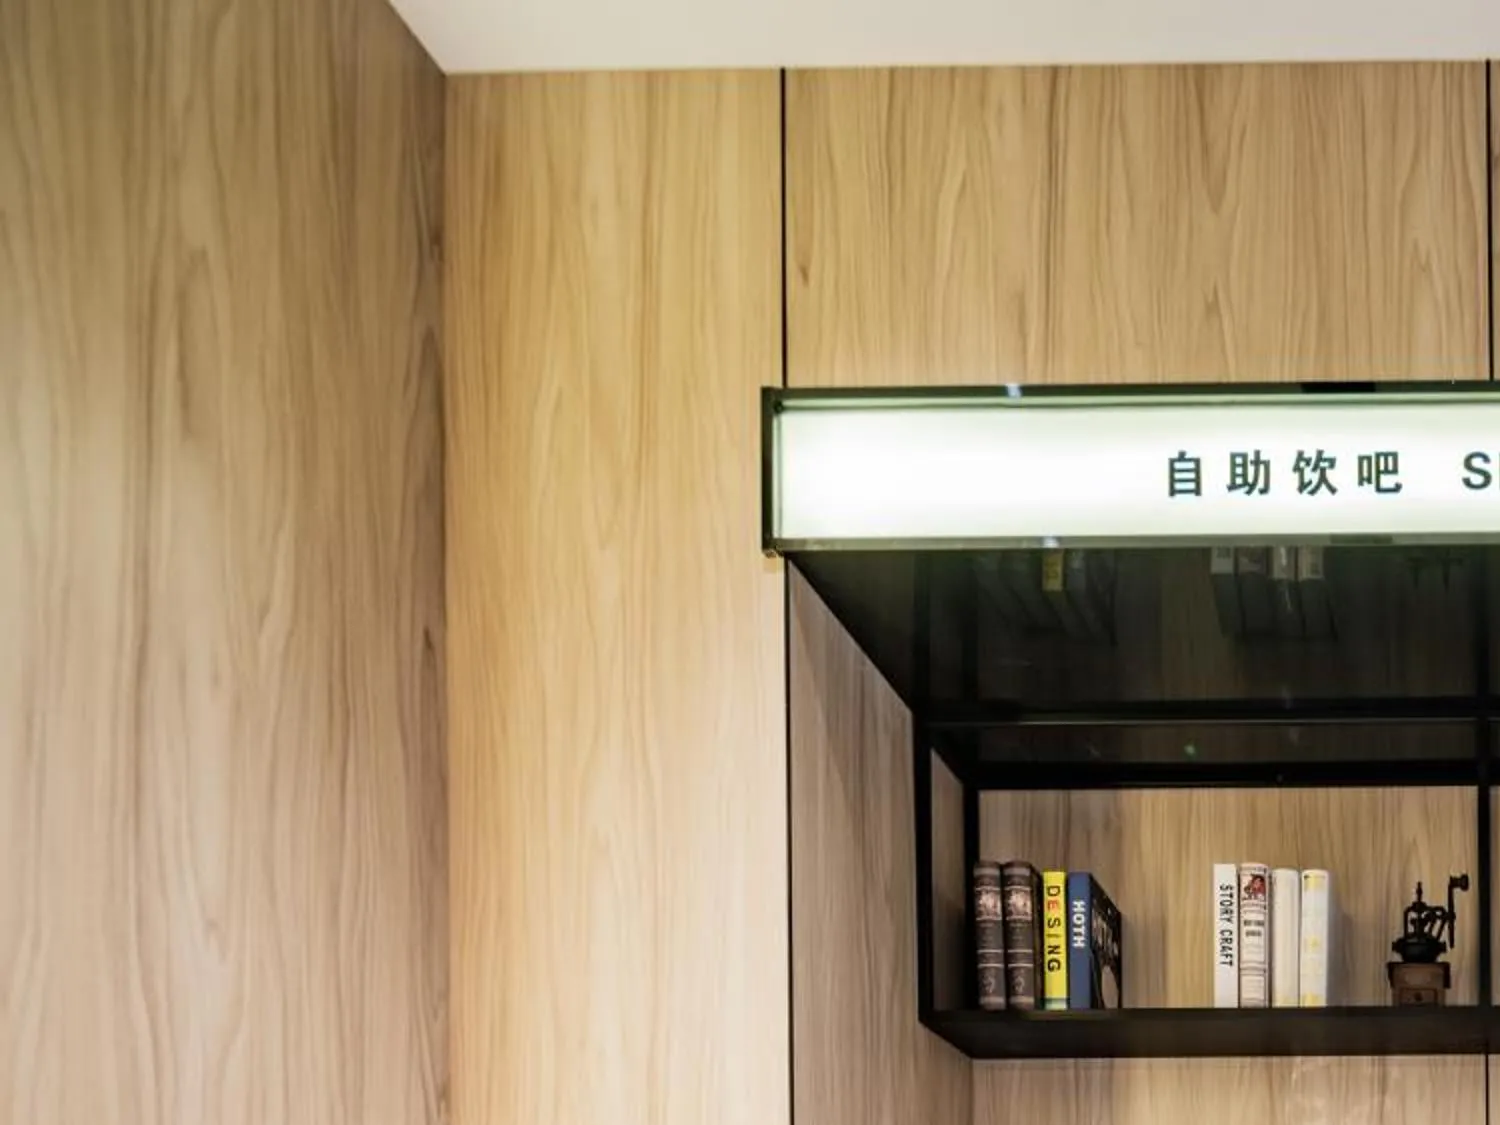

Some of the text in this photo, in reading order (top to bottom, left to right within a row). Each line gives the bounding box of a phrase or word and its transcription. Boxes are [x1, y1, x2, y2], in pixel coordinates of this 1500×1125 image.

[1166, 449, 1403, 498] 自助饮吧
[1047, 885, 1062, 973] DESING
[1072, 900, 1086, 948] HOTH
[1219, 884, 1234, 967] STORY CRAFT
